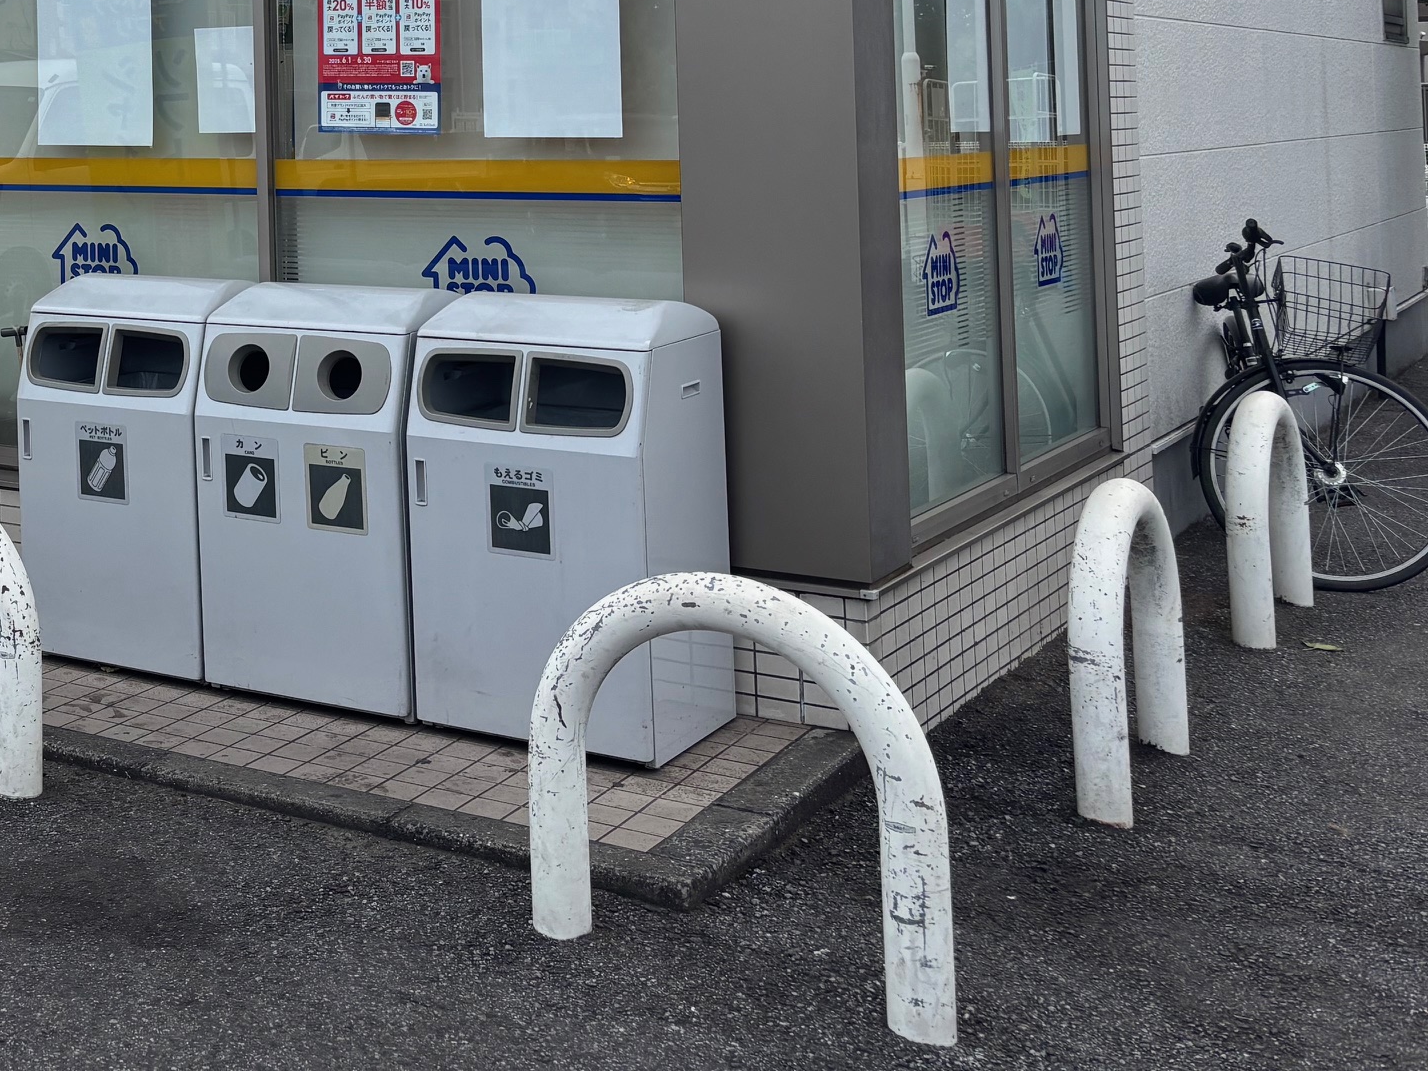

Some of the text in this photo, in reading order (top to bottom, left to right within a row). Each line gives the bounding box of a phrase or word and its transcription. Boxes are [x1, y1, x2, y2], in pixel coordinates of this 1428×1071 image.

[332, 0, 354, 11] 20%
[72, 241, 118, 264] MINI
[1040, 232, 1057, 255] MINI
[447, 256, 510, 281] MINI
[930, 252, 952, 280] MINI
[1040, 254, 1058, 278] STOP
[931, 277, 953, 306] STOP
[80, 424, 123, 437] ペットボトル
[493, 467, 543, 483] もえるゴミ
[502, 479, 536, 488] COMBUSTIBLES
